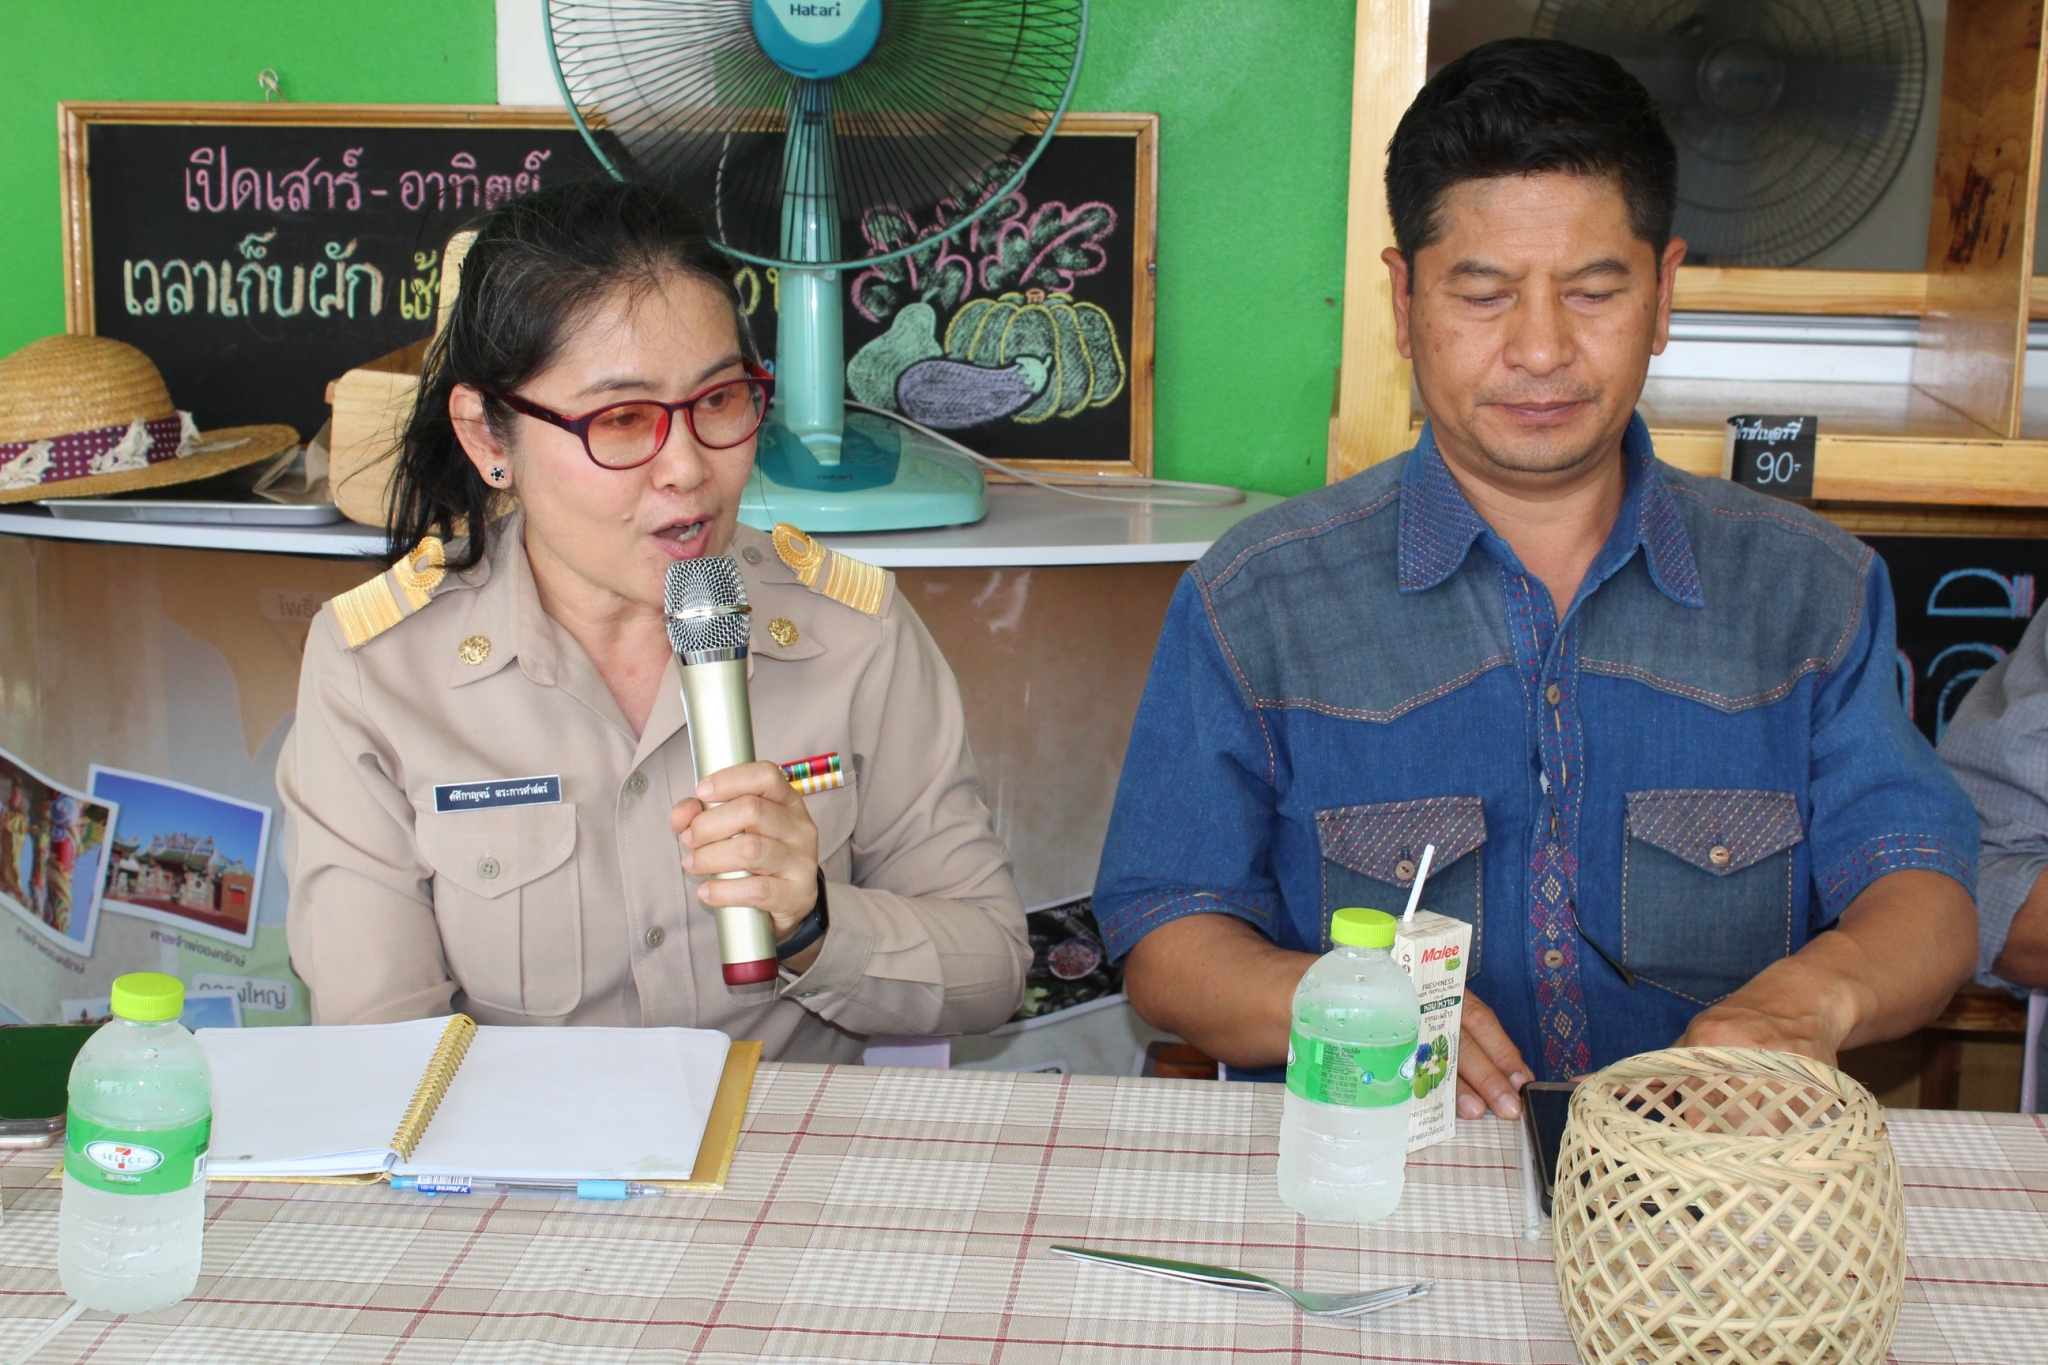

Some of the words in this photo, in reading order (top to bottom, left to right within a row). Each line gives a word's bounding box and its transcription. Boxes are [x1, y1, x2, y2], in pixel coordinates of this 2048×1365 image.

[791, 2, 840, 16] Hatari
[123, 228, 384, 318] เวลาเก็บผัก
[400, 249, 441, 321] เช้
[1421, 945, 1460, 964] Malee
[1422, 977, 1455, 991] FRESHNESS
[102, 1153, 143, 1164] SELECT
